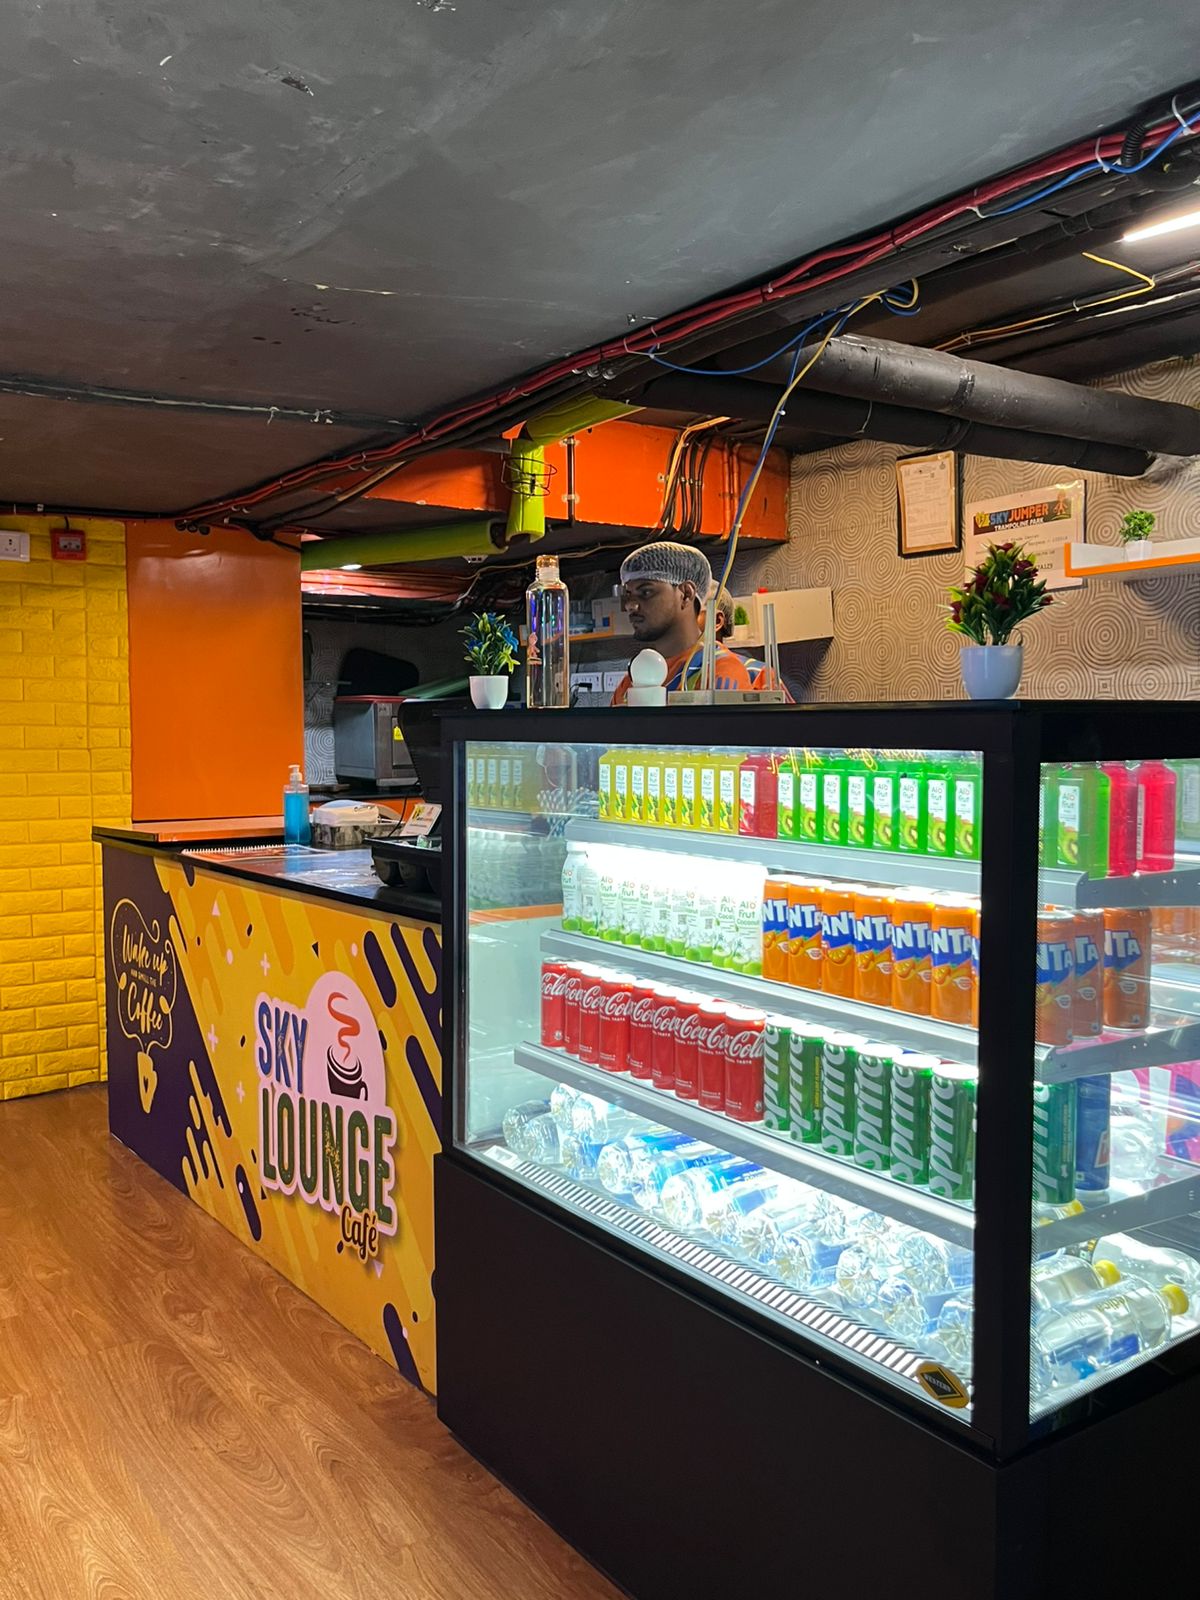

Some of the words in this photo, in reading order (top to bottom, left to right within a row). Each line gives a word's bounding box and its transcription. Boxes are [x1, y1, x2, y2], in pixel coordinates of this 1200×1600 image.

[994, 519, 1030, 532] TRAMPOLINE
[1030, 517, 1044, 526] PARK
[122, 924, 151, 969] Wake
[153, 951, 169, 987] up
[128, 981, 163, 1034] Coffee
[257, 1000, 308, 1094] SKY
[853, 1051, 892, 1171] Sprite
[890, 1064, 924, 1184] Sprite
[262, 1087, 393, 1225] LOUNGE
[341, 1205, 378, 1260] Café
